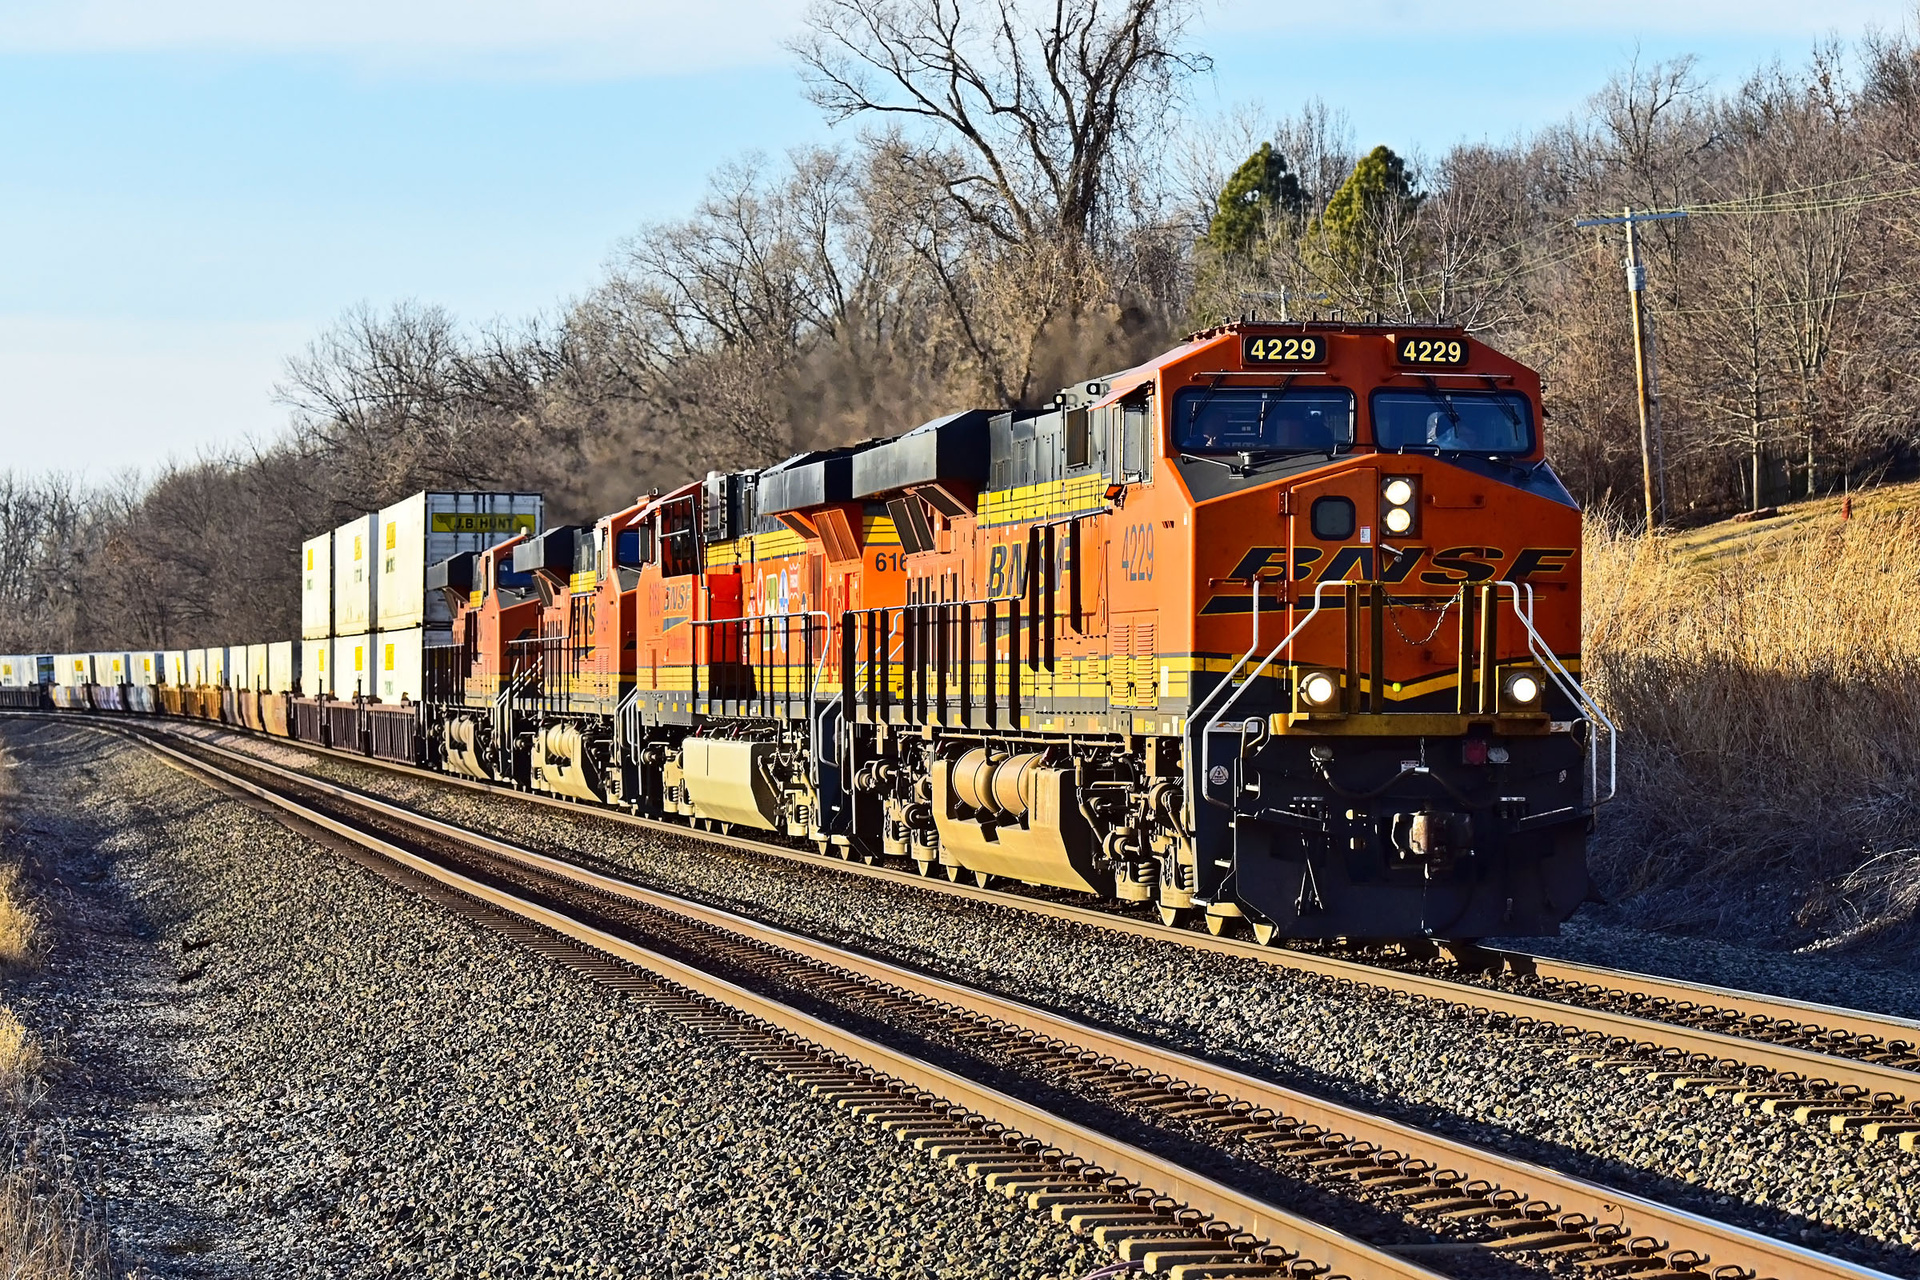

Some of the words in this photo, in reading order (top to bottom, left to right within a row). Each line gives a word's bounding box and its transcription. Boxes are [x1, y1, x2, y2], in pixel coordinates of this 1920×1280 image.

[1251, 339, 1316, 360] 4229
[1403, 341, 1461, 362] 4229
[480, 518, 513, 530] HUNT
[1122, 523, 1154, 581] 4229
[1226, 546, 1576, 585] BNSF
